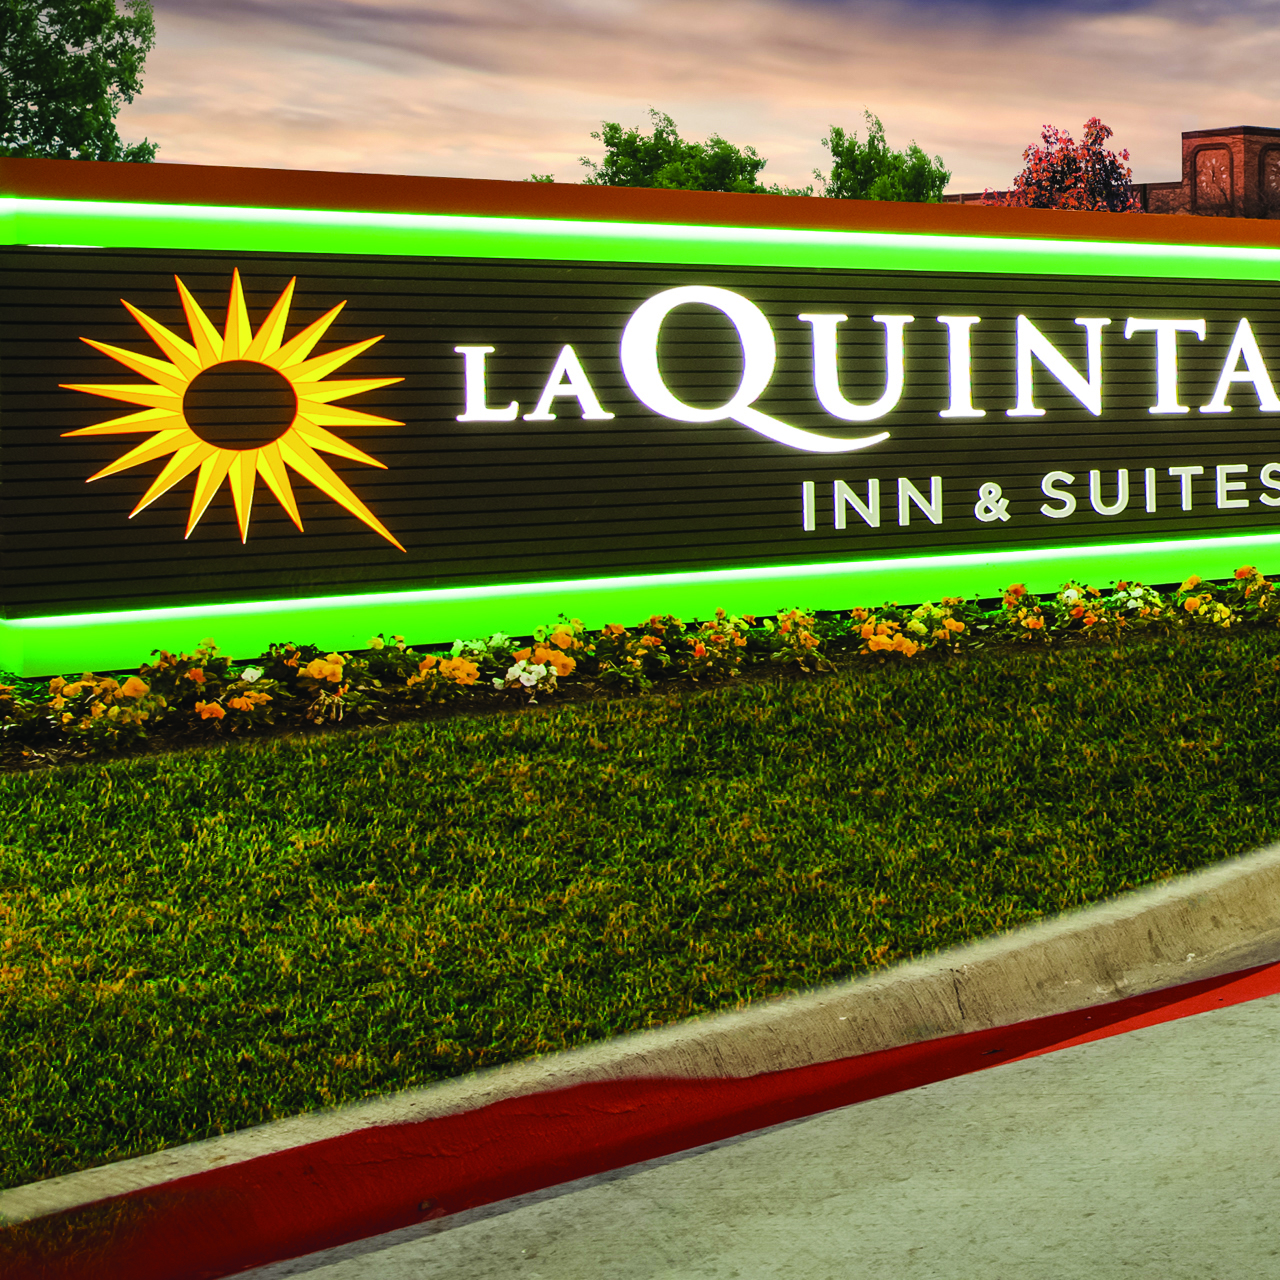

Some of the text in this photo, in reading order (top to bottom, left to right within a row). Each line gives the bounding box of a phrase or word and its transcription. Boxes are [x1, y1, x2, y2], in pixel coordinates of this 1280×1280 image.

[454, 345, 616, 422] LA
[802, 476, 943, 532] INN
[974, 482, 1011, 523] &
